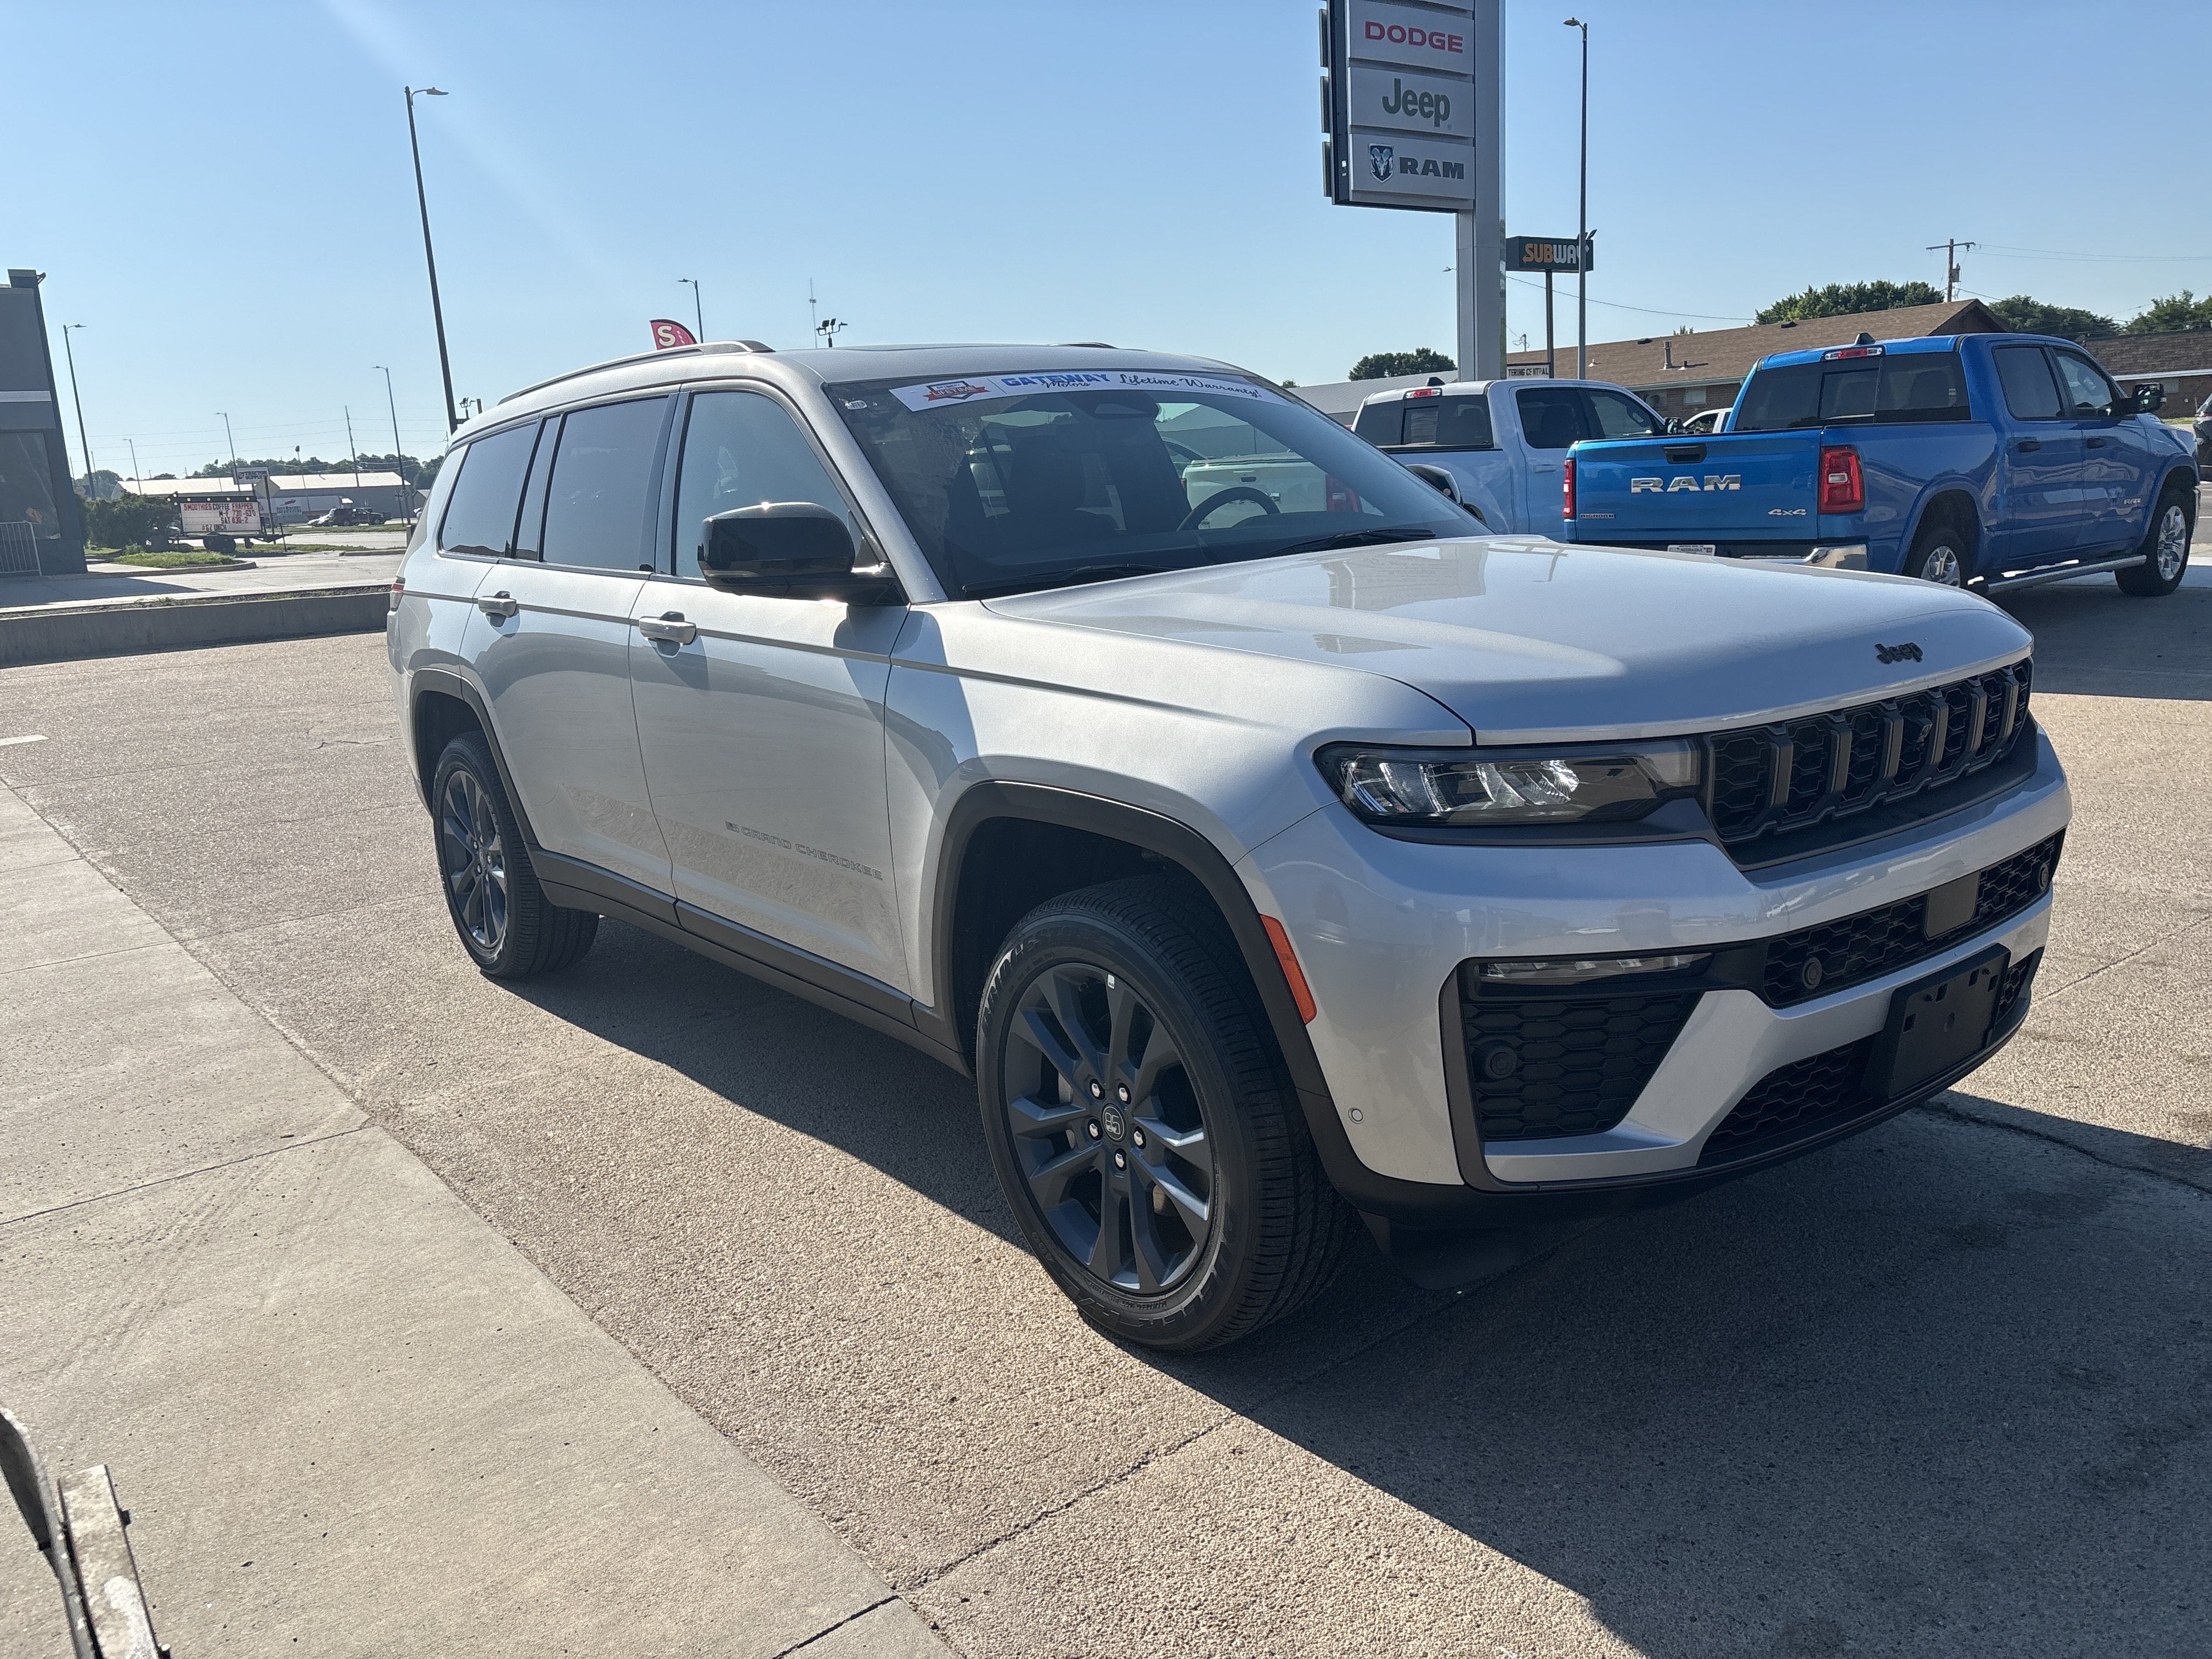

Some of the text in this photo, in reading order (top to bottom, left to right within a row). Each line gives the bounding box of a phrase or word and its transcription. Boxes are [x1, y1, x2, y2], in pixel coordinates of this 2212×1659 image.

[1365, 20, 1463, 53] DODGE
[1382, 78, 1451, 127] Jeep
[1400, 157, 1464, 180] RAM
[932, 386, 975, 396] LIFETIME
[1001, 374, 1110, 387] GATEWAY
[1042, 381, 1091, 389] Motors
[1119, 374, 1262, 398] Lifetime Warranty!
[1631, 474, 1741, 493] RAM
[1875, 642, 1923, 664] Jeep
[741, 826, 883, 881] GRAND CHEROKEE
